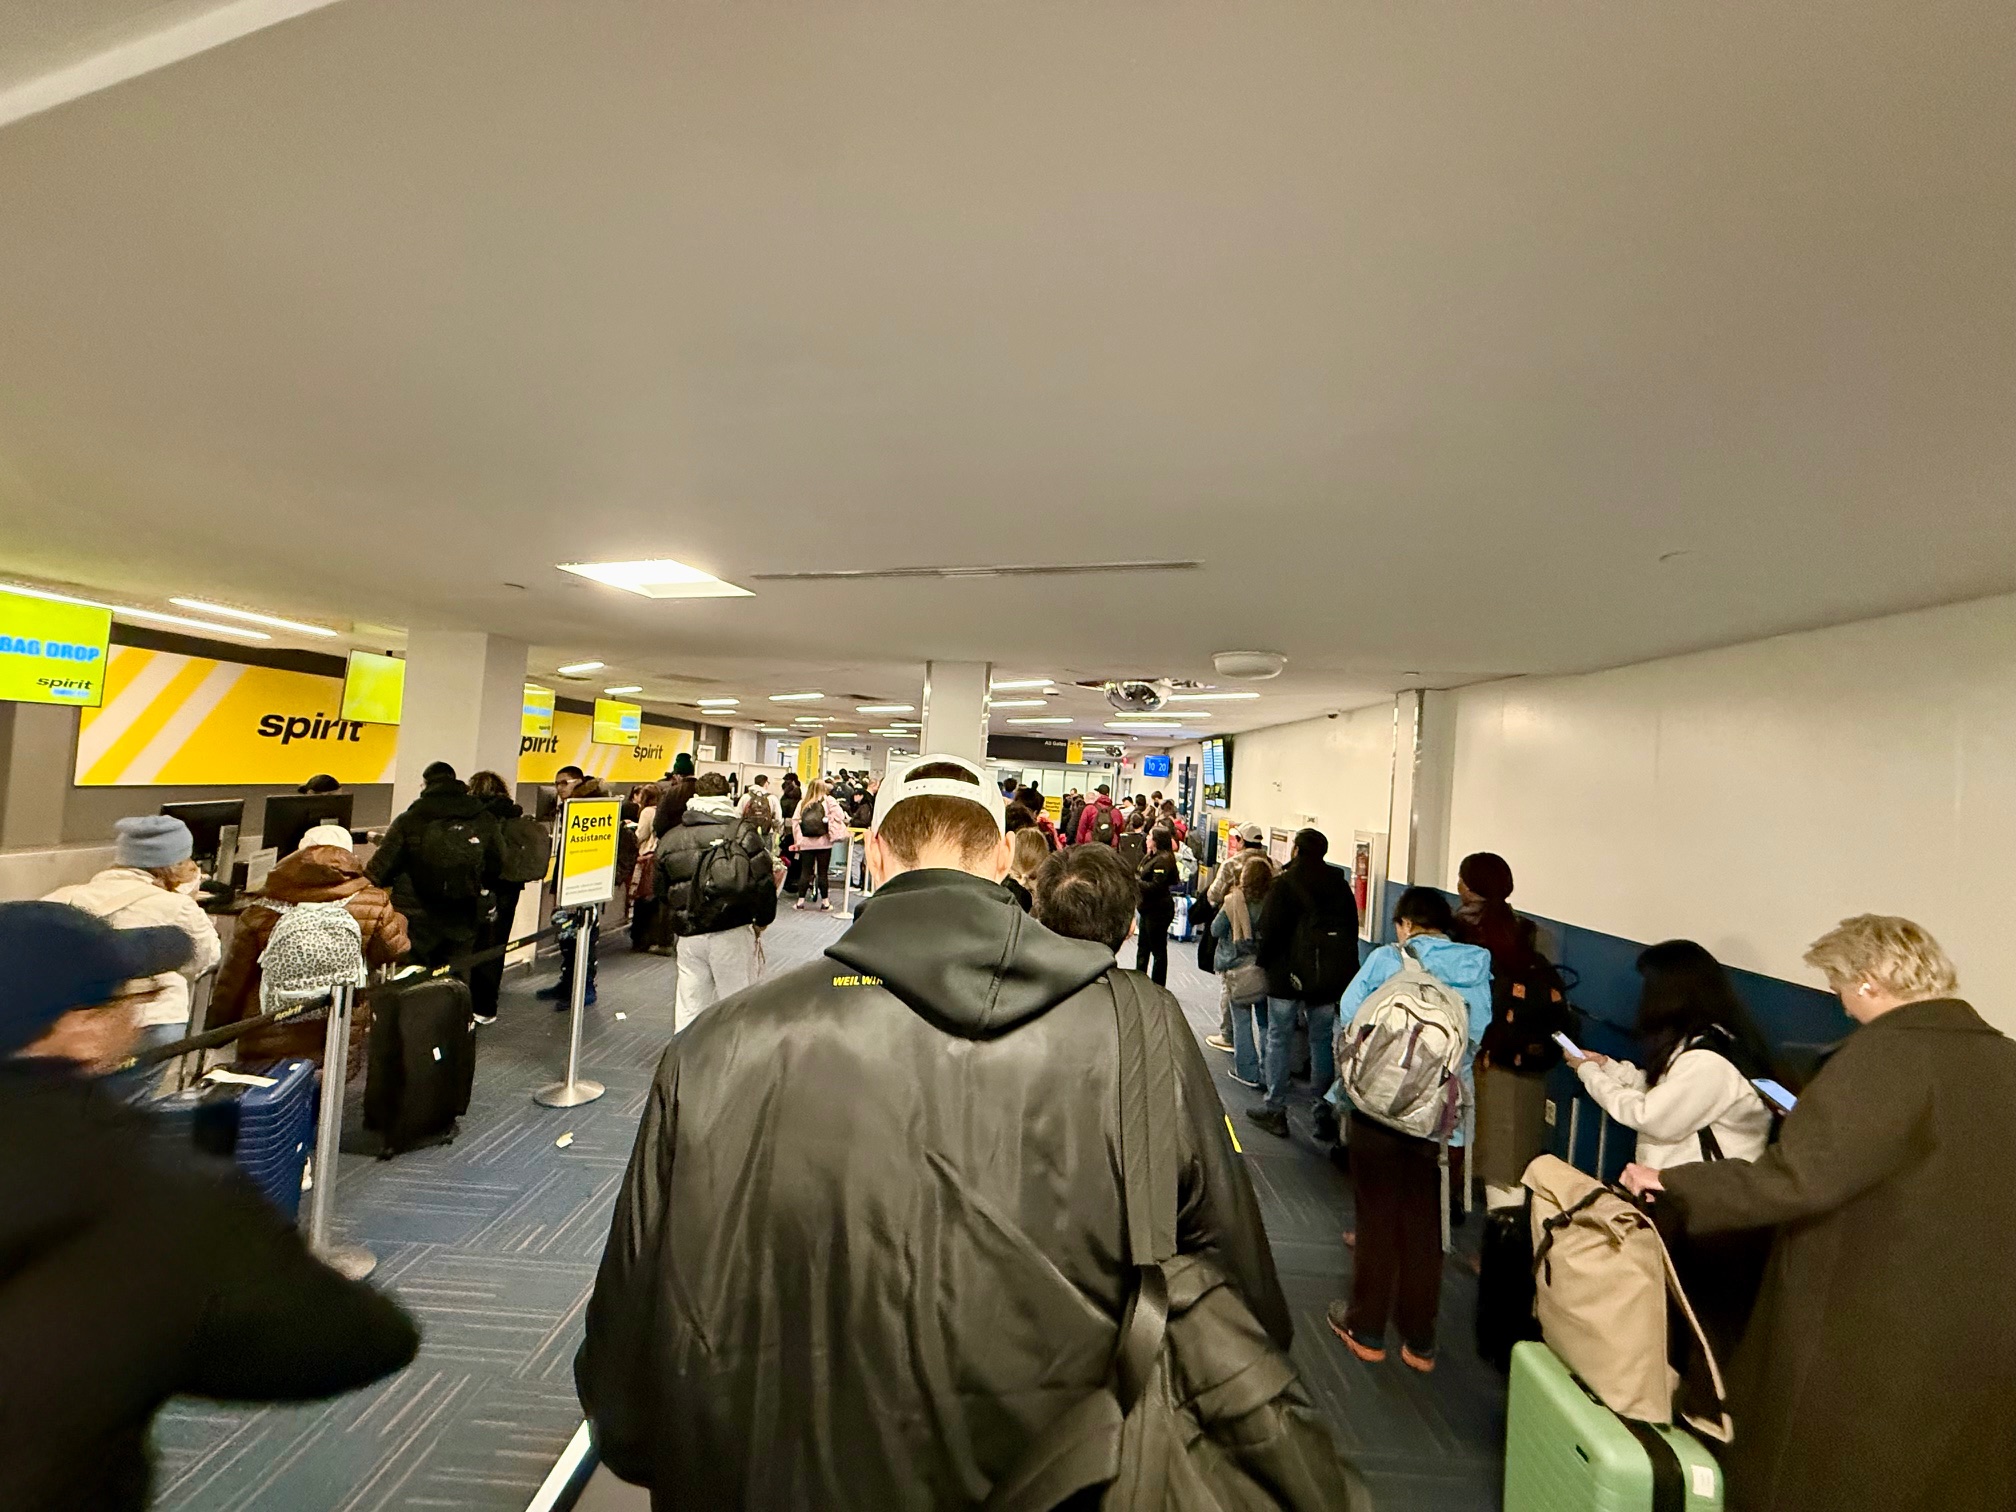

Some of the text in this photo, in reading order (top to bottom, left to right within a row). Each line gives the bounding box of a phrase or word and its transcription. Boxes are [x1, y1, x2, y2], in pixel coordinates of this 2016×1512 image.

[0, 636, 99, 661] BAG DROP
[36, 678, 93, 689] spirit
[257, 712, 363, 745] spirit
[519, 735, 559, 757] pirit
[633, 744, 664, 762] spirit
[1158, 762, 1167, 772] 20
[571, 813, 613, 832] Agent
[570, 833, 612, 844] Assistance
